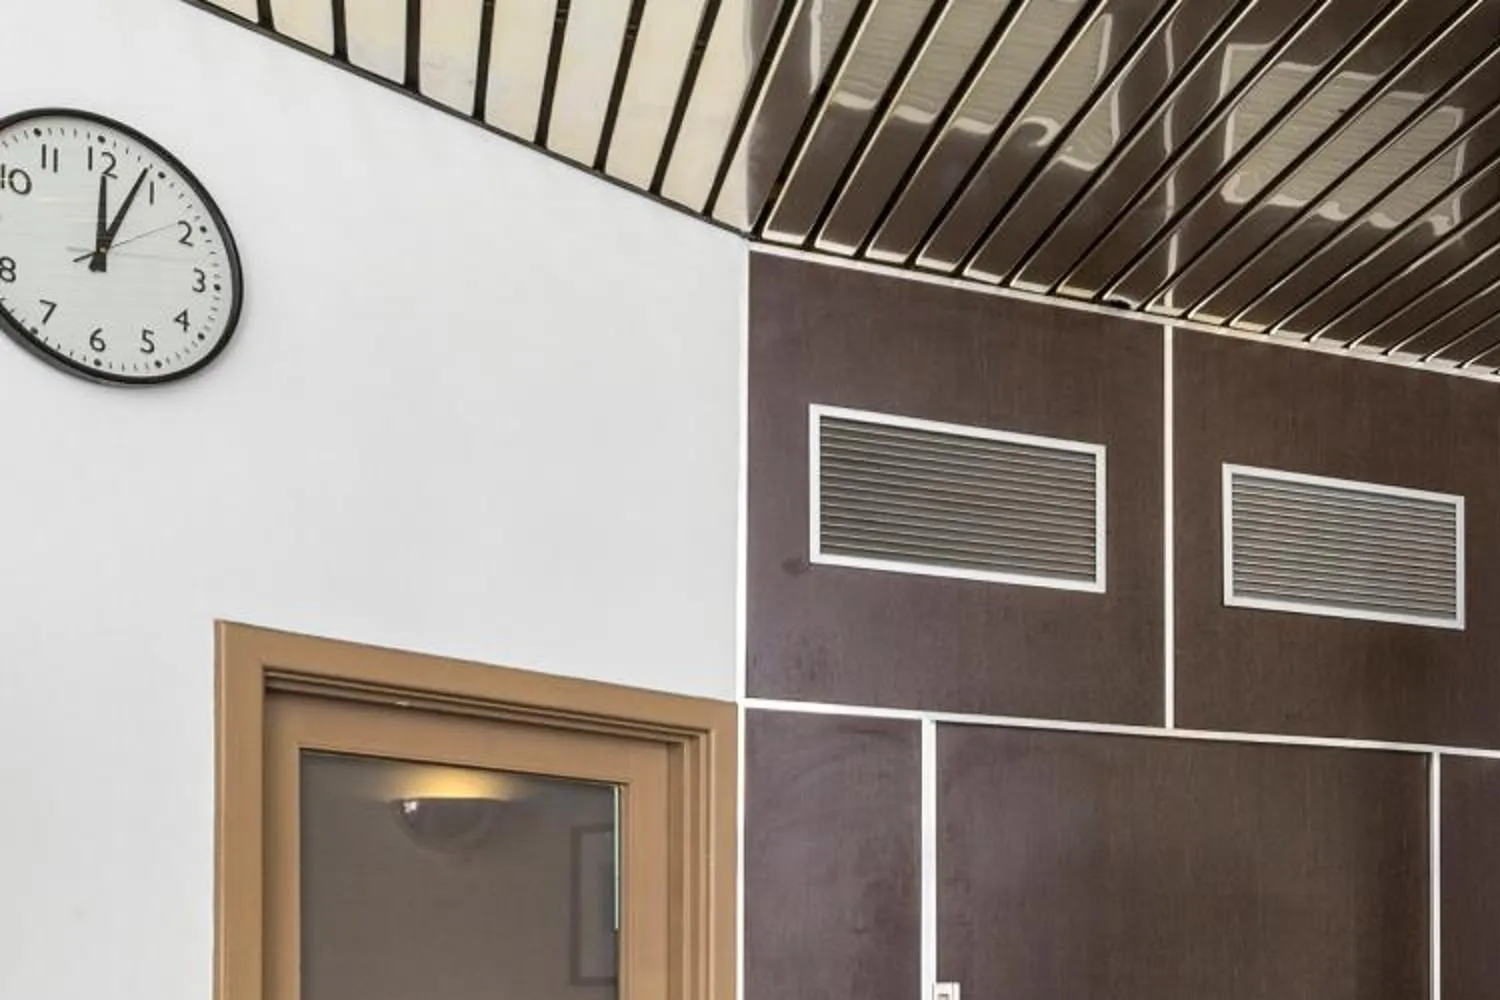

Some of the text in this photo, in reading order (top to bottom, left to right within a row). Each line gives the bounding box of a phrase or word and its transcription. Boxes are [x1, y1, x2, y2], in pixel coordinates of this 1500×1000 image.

[41, 144, 59, 173] 11
[88, 146, 119, 179] 12
[149, 180, 155, 206] 1
[177, 220, 195, 247] 2
[0, 256, 17, 283] 8
[192, 268, 207, 293] 3
[39, 299, 57, 325] 7
[174, 308, 191, 333] 4
[89, 328, 107, 353] 6
[140, 329, 156, 354] 5
